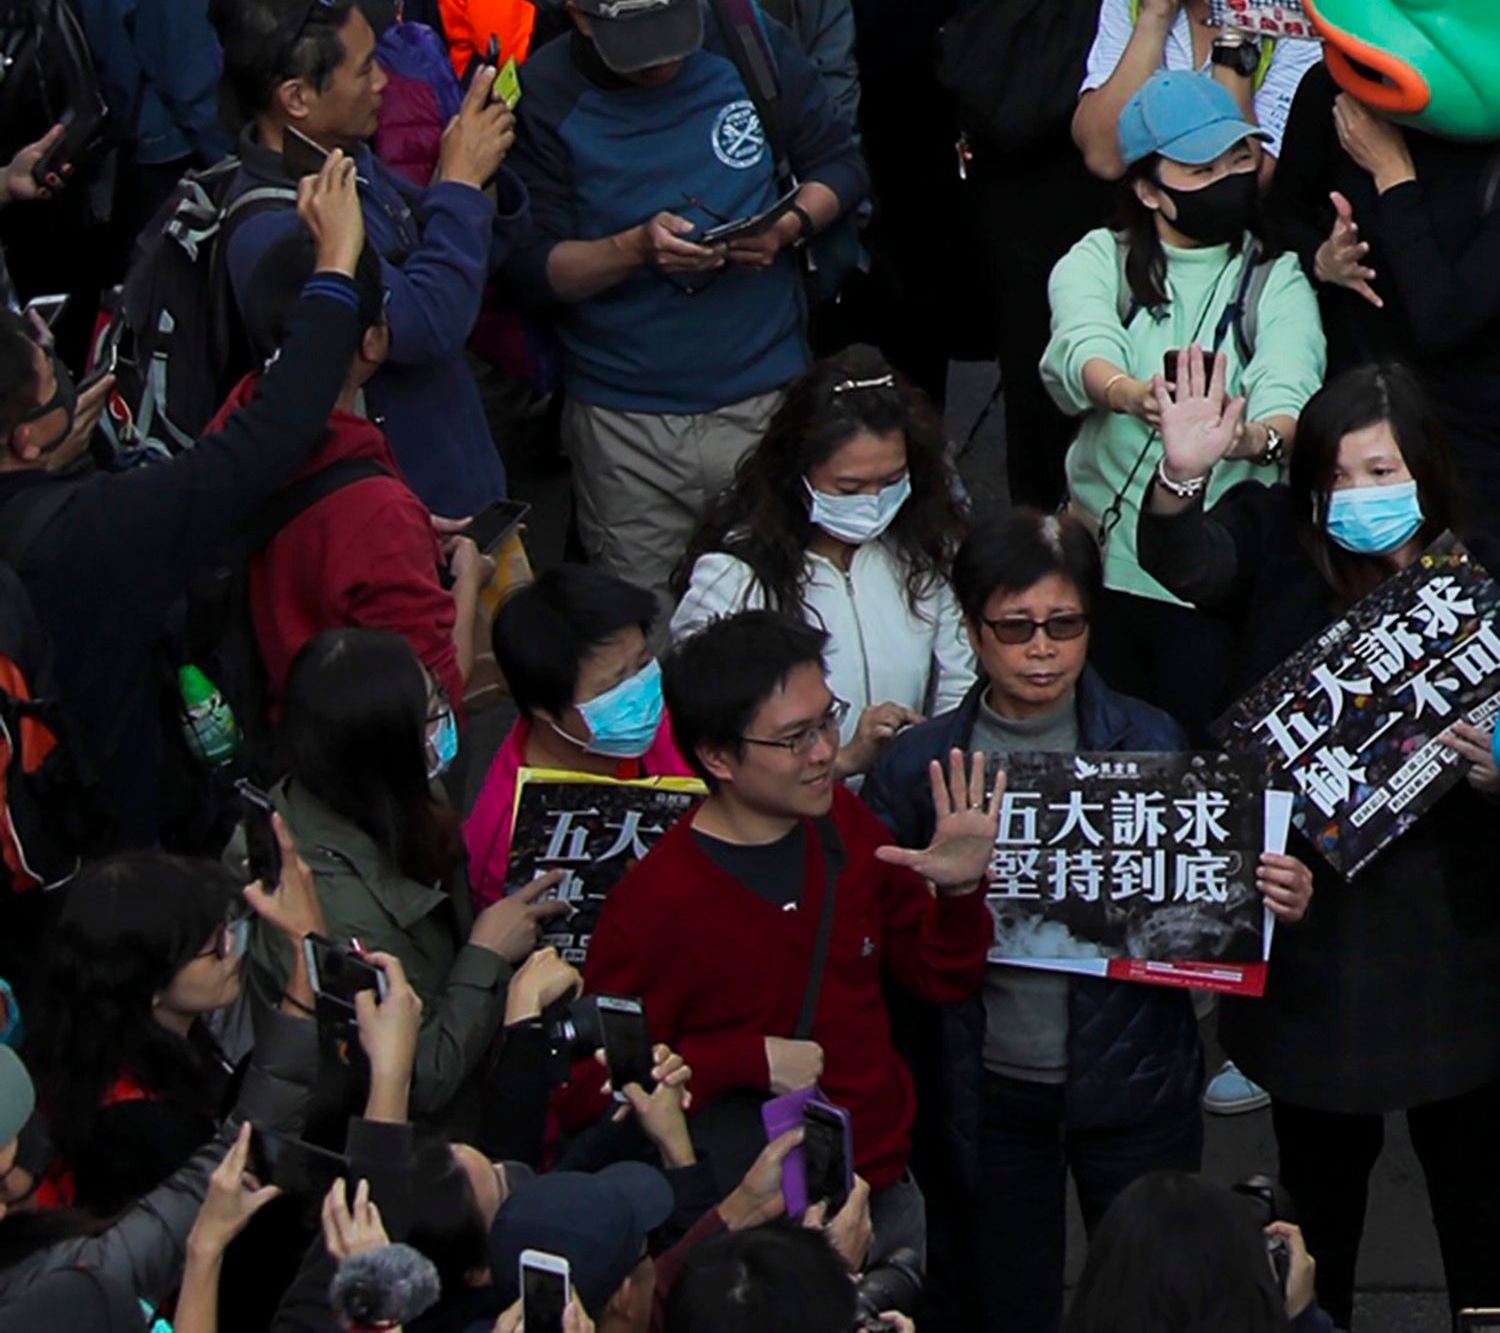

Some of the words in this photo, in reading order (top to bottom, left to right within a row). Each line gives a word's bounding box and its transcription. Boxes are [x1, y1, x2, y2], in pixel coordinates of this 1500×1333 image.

[1251, 575, 1476, 770] 五大訴求
[987, 790, 1231, 848] 五大訴求
[987, 849, 1231, 903] 堅持到底
